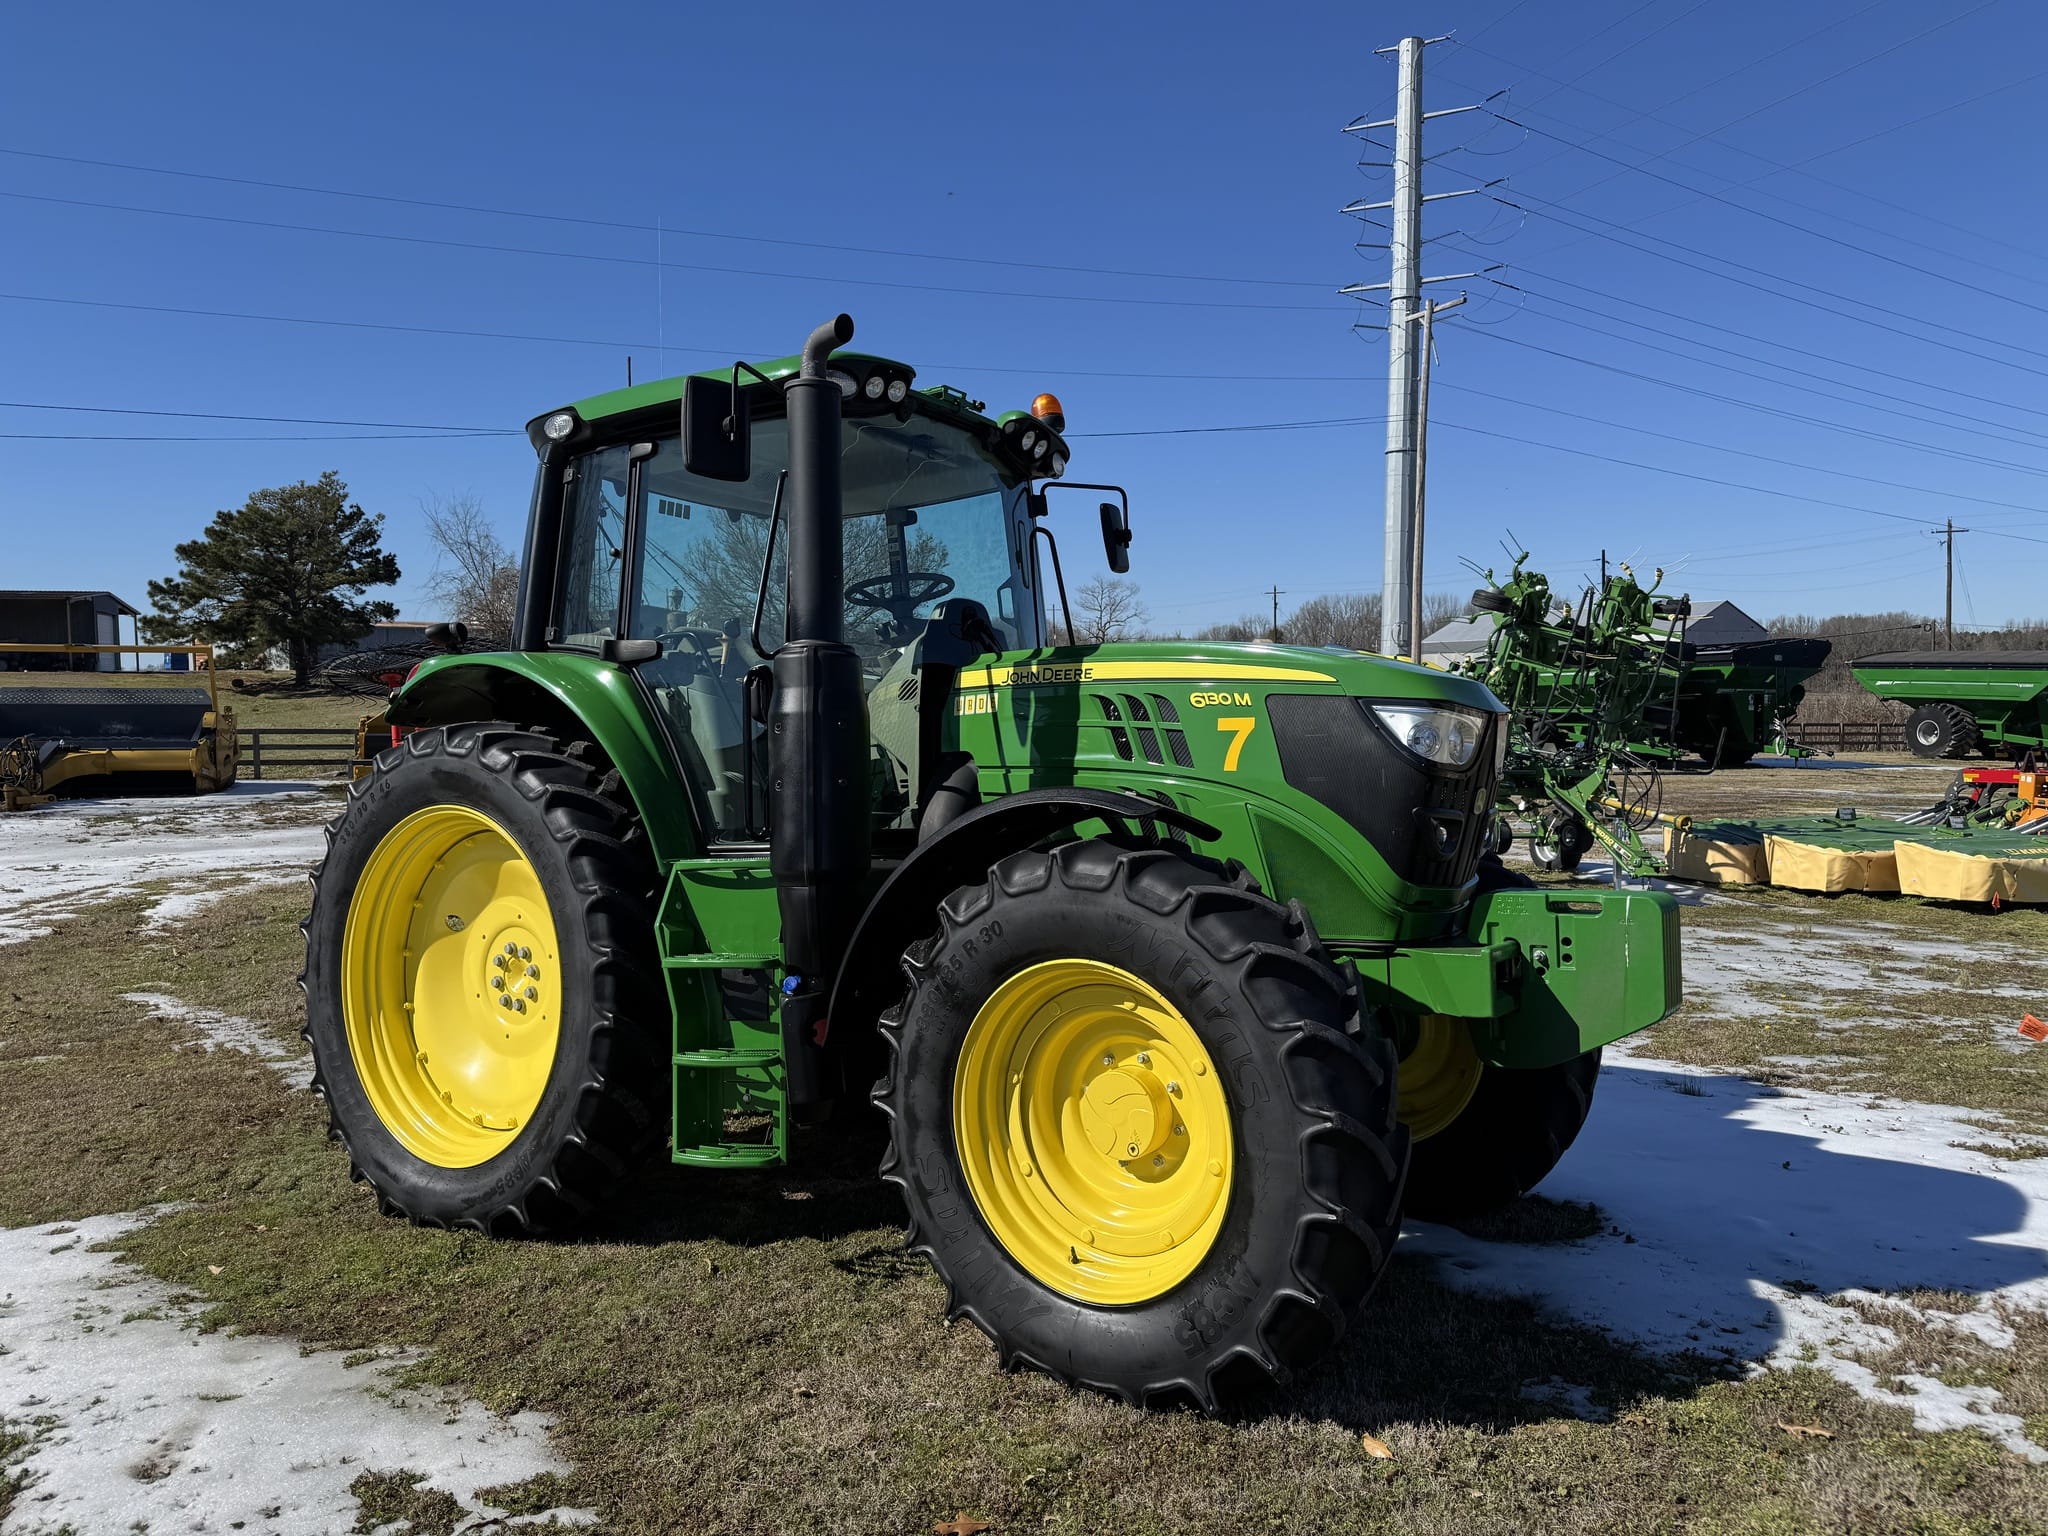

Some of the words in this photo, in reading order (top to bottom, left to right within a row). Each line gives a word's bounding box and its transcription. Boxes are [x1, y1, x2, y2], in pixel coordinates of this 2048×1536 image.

[1002, 670, 1040, 684] JOHN
[1043, 667, 1094, 682] DEERE
[1190, 692, 1232, 708] 6130
[1217, 716, 1256, 772] 7
